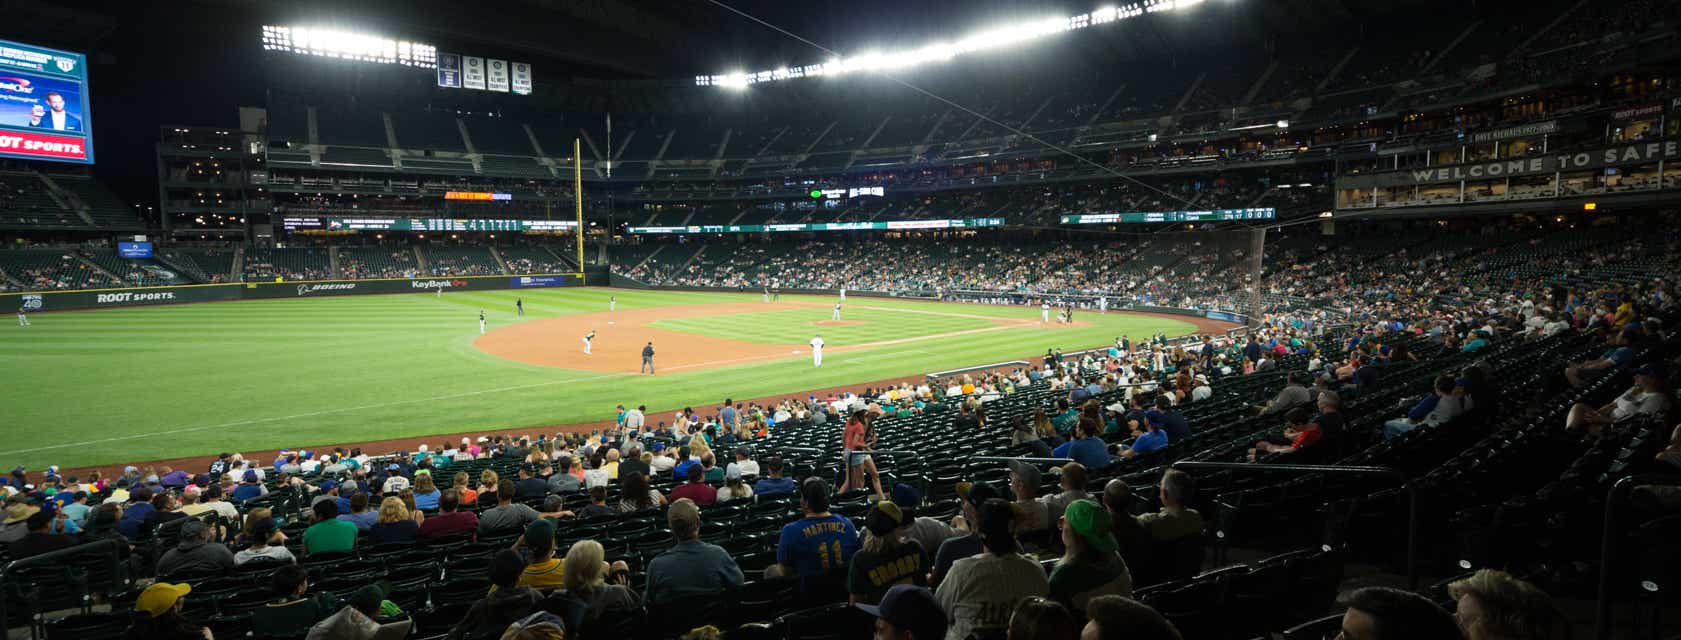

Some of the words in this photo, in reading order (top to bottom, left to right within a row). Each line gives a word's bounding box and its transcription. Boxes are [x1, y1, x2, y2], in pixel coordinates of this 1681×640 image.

[1412, 158, 1544, 182] WELCOME
[1557, 153, 1591, 169] TO
[97, 292, 132, 303] ROOT
[210, 464, 224, 473] 24
[802, 521, 847, 537] MARTINEZ
[818, 539, 844, 568] 11
